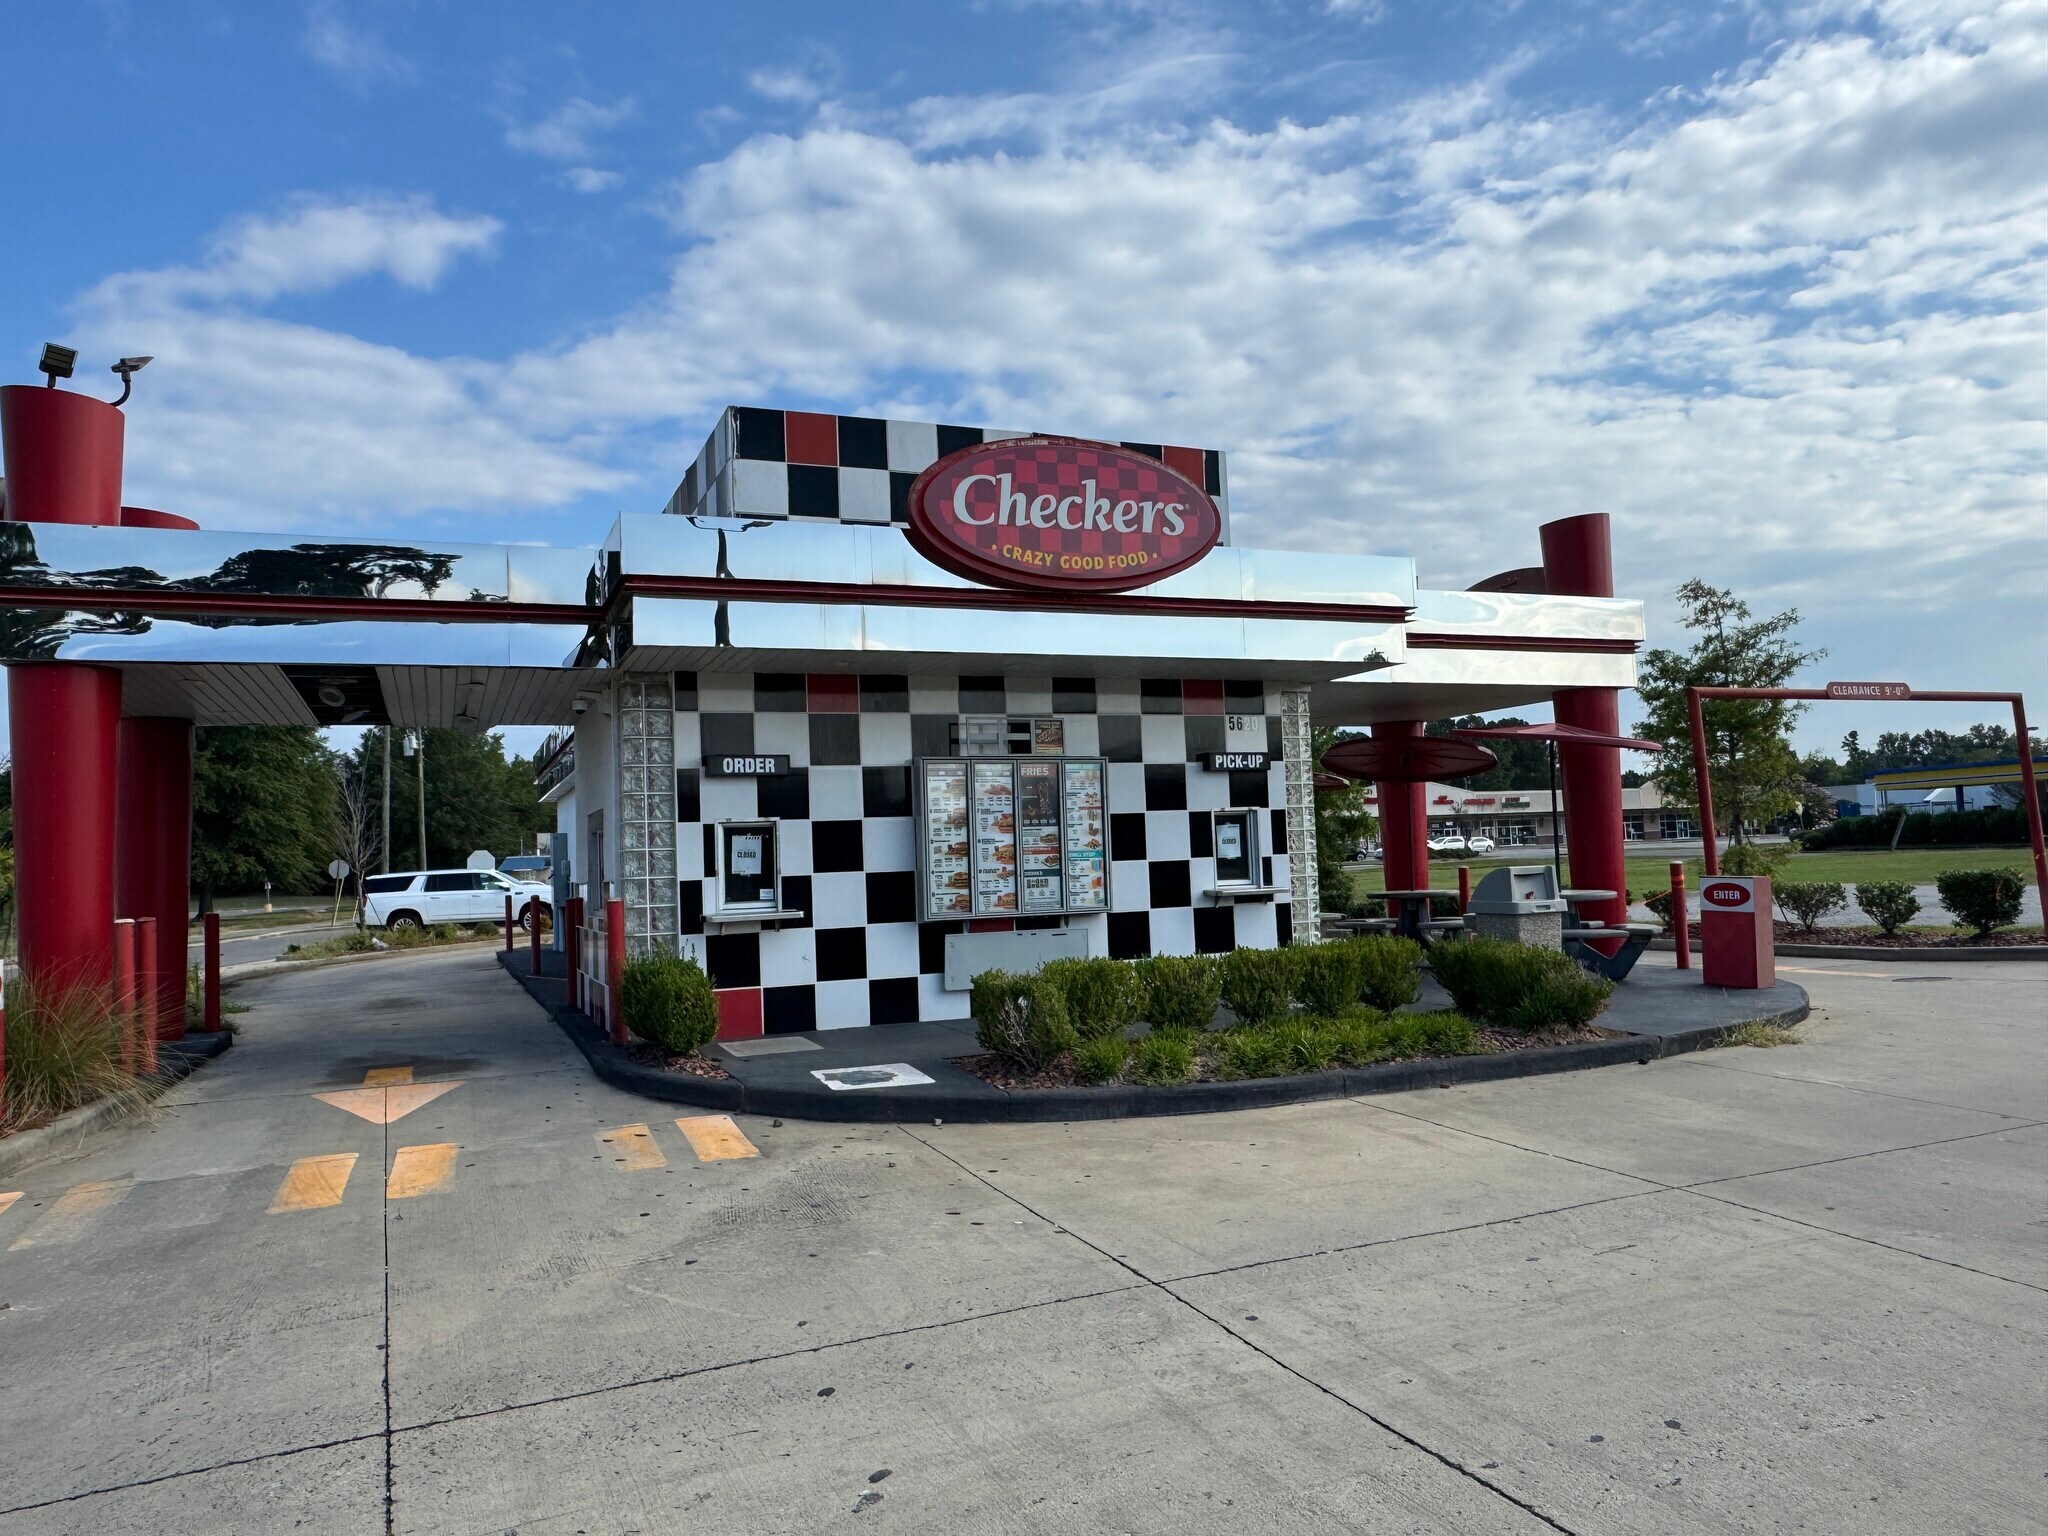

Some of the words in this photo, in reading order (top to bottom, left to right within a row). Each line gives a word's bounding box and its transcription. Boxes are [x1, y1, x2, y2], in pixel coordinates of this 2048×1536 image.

[953, 473, 1185, 536] Checkers
[1003, 544, 1053, 567] CRAZY
[1060, 555, 1104, 570] GOOD
[1108, 551, 1149, 569] FOOD
[1832, 685, 1881, 696] CLEARANCE
[723, 757, 775, 774] ORDER
[1215, 754, 1264, 769] PICK-UP
[1020, 767, 1049, 776] FRIES
[736, 851, 757, 859] CLOSED
[1713, 890, 1740, 900] ENTER
